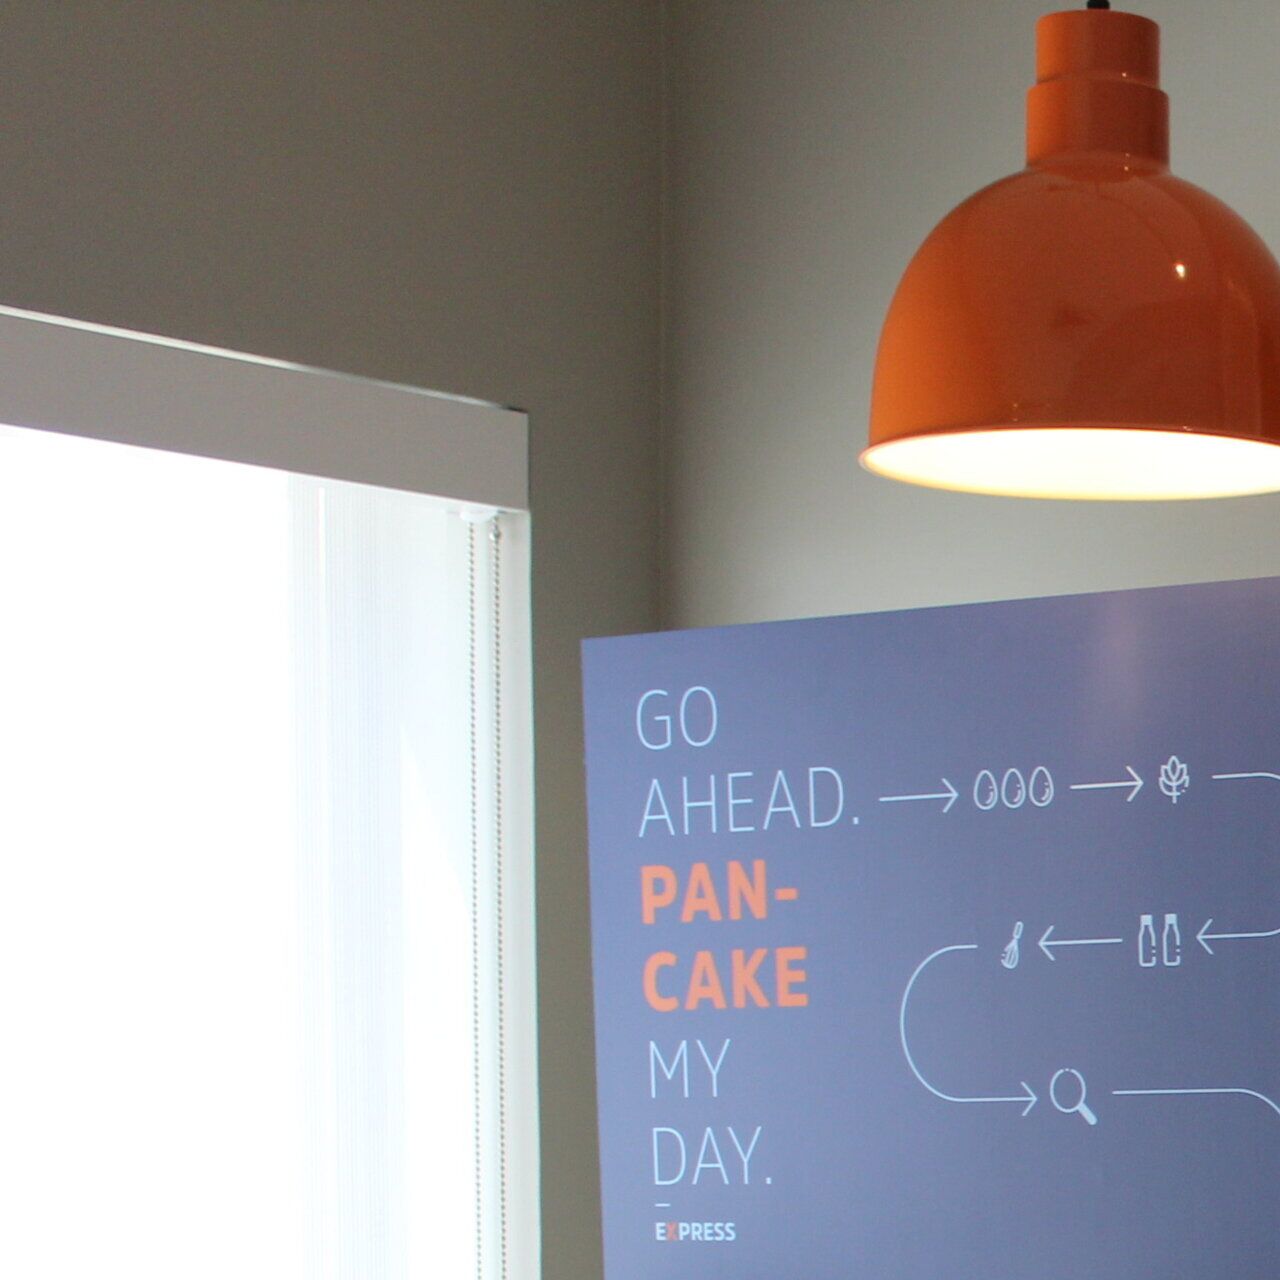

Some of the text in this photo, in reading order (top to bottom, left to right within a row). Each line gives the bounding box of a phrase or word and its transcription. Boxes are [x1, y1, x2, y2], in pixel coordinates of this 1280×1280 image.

[636, 685, 718, 750] GO
[638, 766, 861, 838] AHEAD.
[640, 859, 799, 925] PAN-
[642, 945, 809, 1012] CAKE
[650, 1038, 730, 1099] MY
[652, 1126, 772, 1186] DAY.
[655, 1221, 736, 1241] EXPRESS
